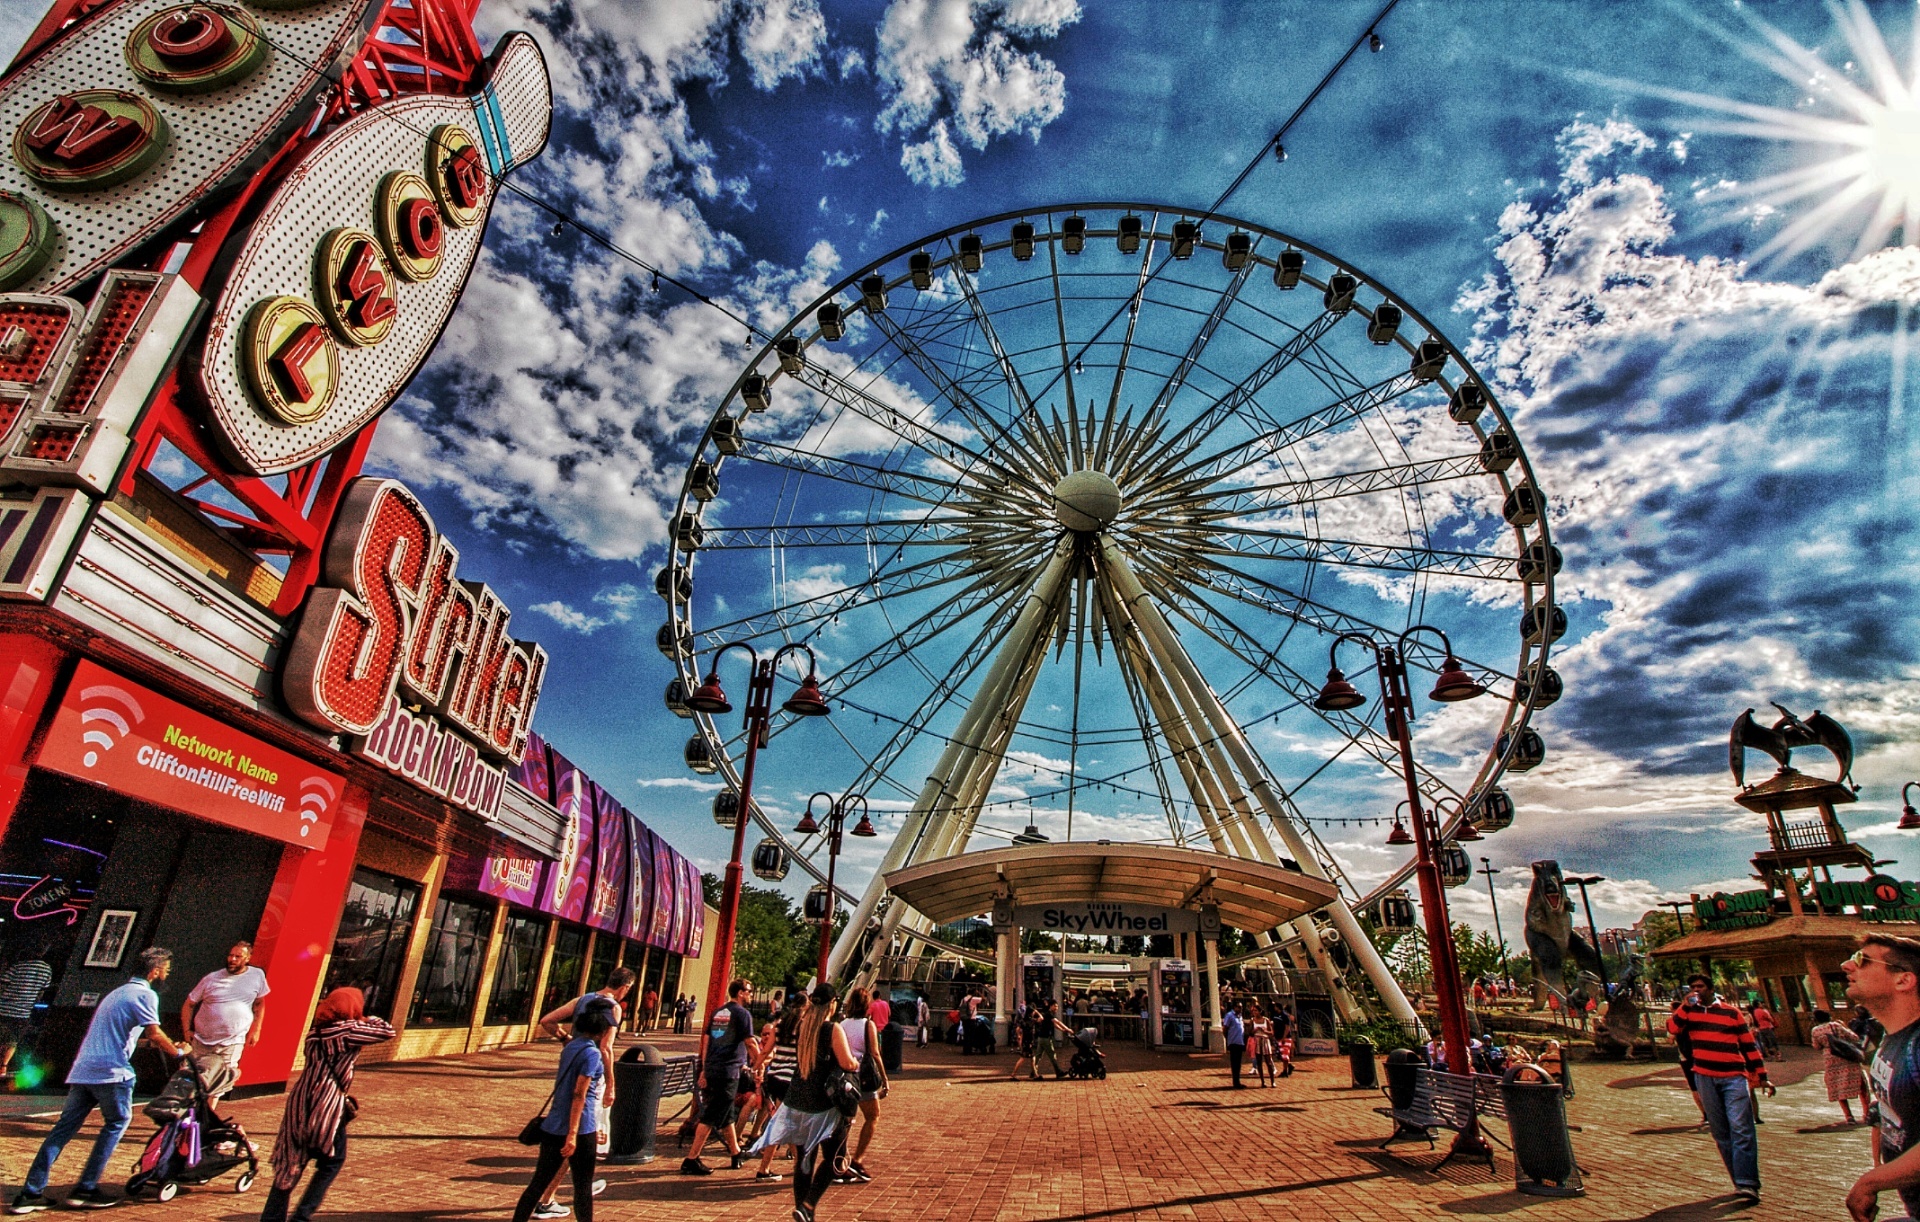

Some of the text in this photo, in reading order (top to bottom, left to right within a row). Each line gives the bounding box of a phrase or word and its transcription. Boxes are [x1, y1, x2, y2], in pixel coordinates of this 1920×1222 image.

[269, 145, 486, 404] BOWL
[136, 745, 286, 813] CliftonHillFreeWifi
[163, 724, 279, 785] Network Name
[24, 884, 71, 910] TOKENS
[1043, 909, 1168, 932] SkyWheel
